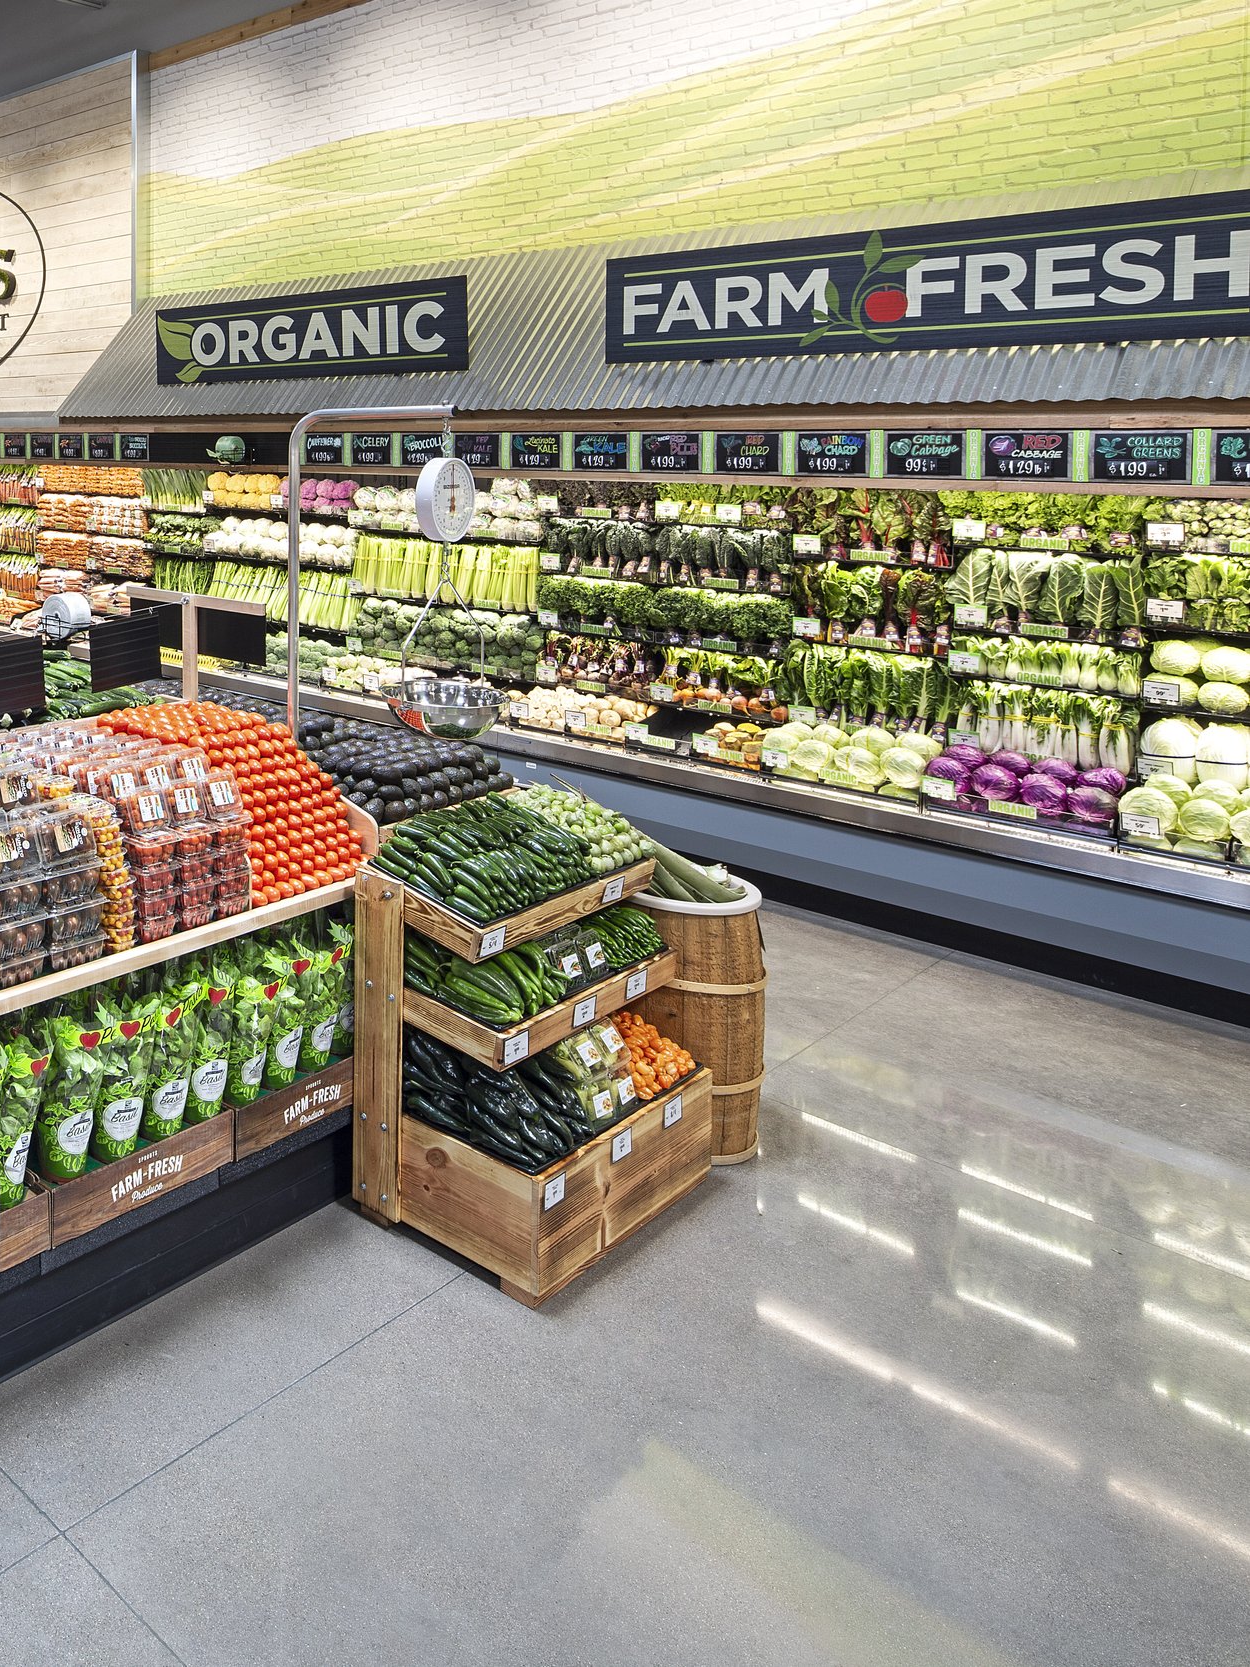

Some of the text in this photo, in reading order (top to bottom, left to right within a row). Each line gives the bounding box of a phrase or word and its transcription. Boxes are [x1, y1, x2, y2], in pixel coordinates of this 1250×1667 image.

[622, 228, 1250, 336] FARM FRESH
[190, 300, 446, 367] ORGANIC
[362, 436, 390, 448] CELERY
[745, 434, 765, 445] RED
[820, 435, 865, 448] RAINBOW
[911, 434, 952, 446] GREEN
[1021, 434, 1063, 450] RED
[1127, 436, 1184, 447] COLLARD
[537, 444, 559, 454] KALE
[593, 442, 627, 454] KALE
[740, 445, 770, 456] CHARD
[824, 445, 859, 456] CHARD
[909, 443, 960, 458] Cabbage
[1011, 449, 1064, 459] CABBAGE
[1132, 447, 1182, 460] GREENS
[582, 508, 611, 517] ORGANIC
[474, 529, 499, 537] ORGANIC
[1022, 537, 1067, 550] ORGANIC
[851, 550, 889, 562] ORGANIC
[582, 567, 611, 576] ORGANIC
[706, 578, 738, 589] ORGANIC
[580, 624, 610, 635] ORGANIC
[1022, 624, 1067, 638] ORGANIC
[703, 639, 736, 650] ORGANIC
[849, 635, 887, 647] ORGANIC
[1016, 673, 1062, 687] ORGANIC
[577, 681, 606, 692] ORGANIC
[699, 700, 732, 713] ORGANIC
[819, 768, 858, 785] ORGANIC
[989, 800, 1036, 819] ORGANIC
[283, 1084, 342, 1125] FARM-FRESH
[110, 1107, 139, 1123] Basil
[299, 1108, 326, 1126] Produce
[110, 1154, 184, 1203] FARM-FRESH
[131, 1181, 164, 1204] Produce
